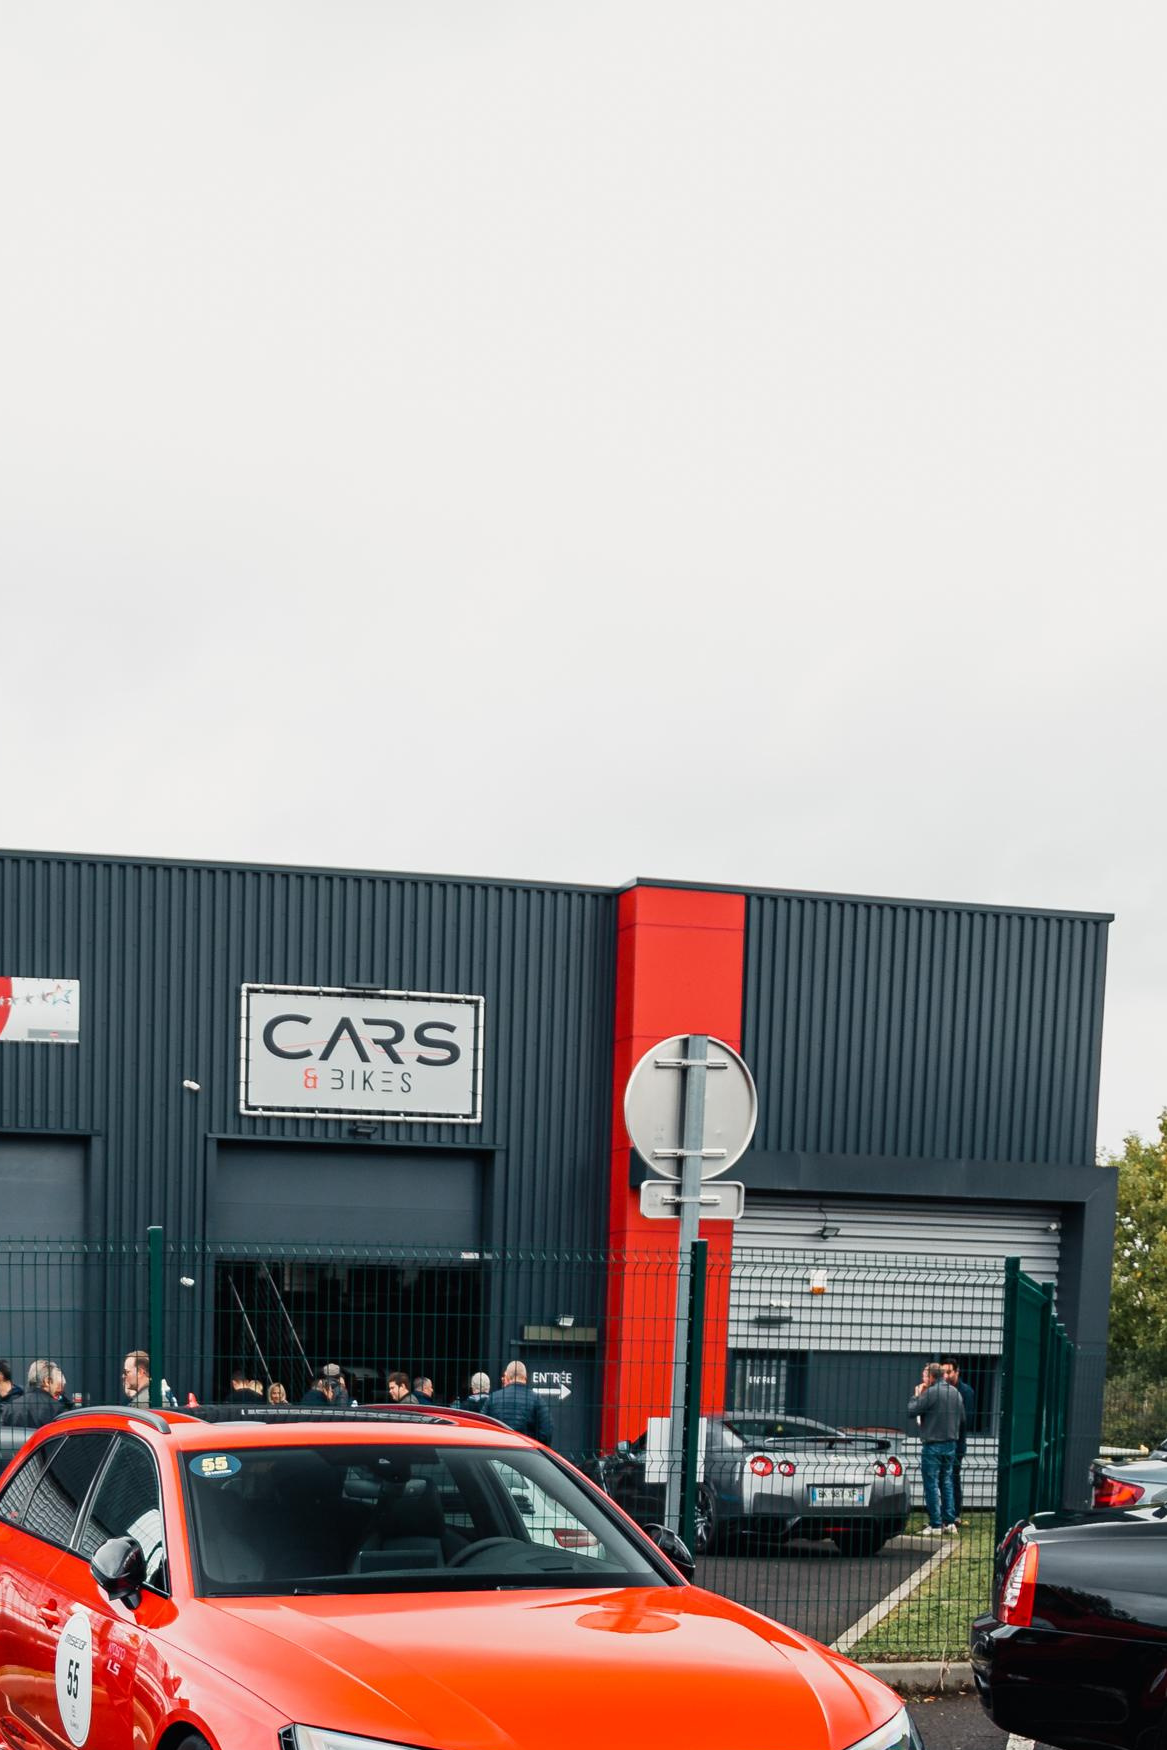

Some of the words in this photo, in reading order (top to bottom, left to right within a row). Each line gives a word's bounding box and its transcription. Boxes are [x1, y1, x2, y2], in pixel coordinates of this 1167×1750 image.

[262, 1013, 461, 1067] CARS
[303, 1067, 319, 1089] &
[331, 1068, 413, 1093] BIKES
[532, 1370, 572, 1384] ENTRÉE
[202, 1456, 228, 1471] 55
[66, 1658, 80, 1699] 55
